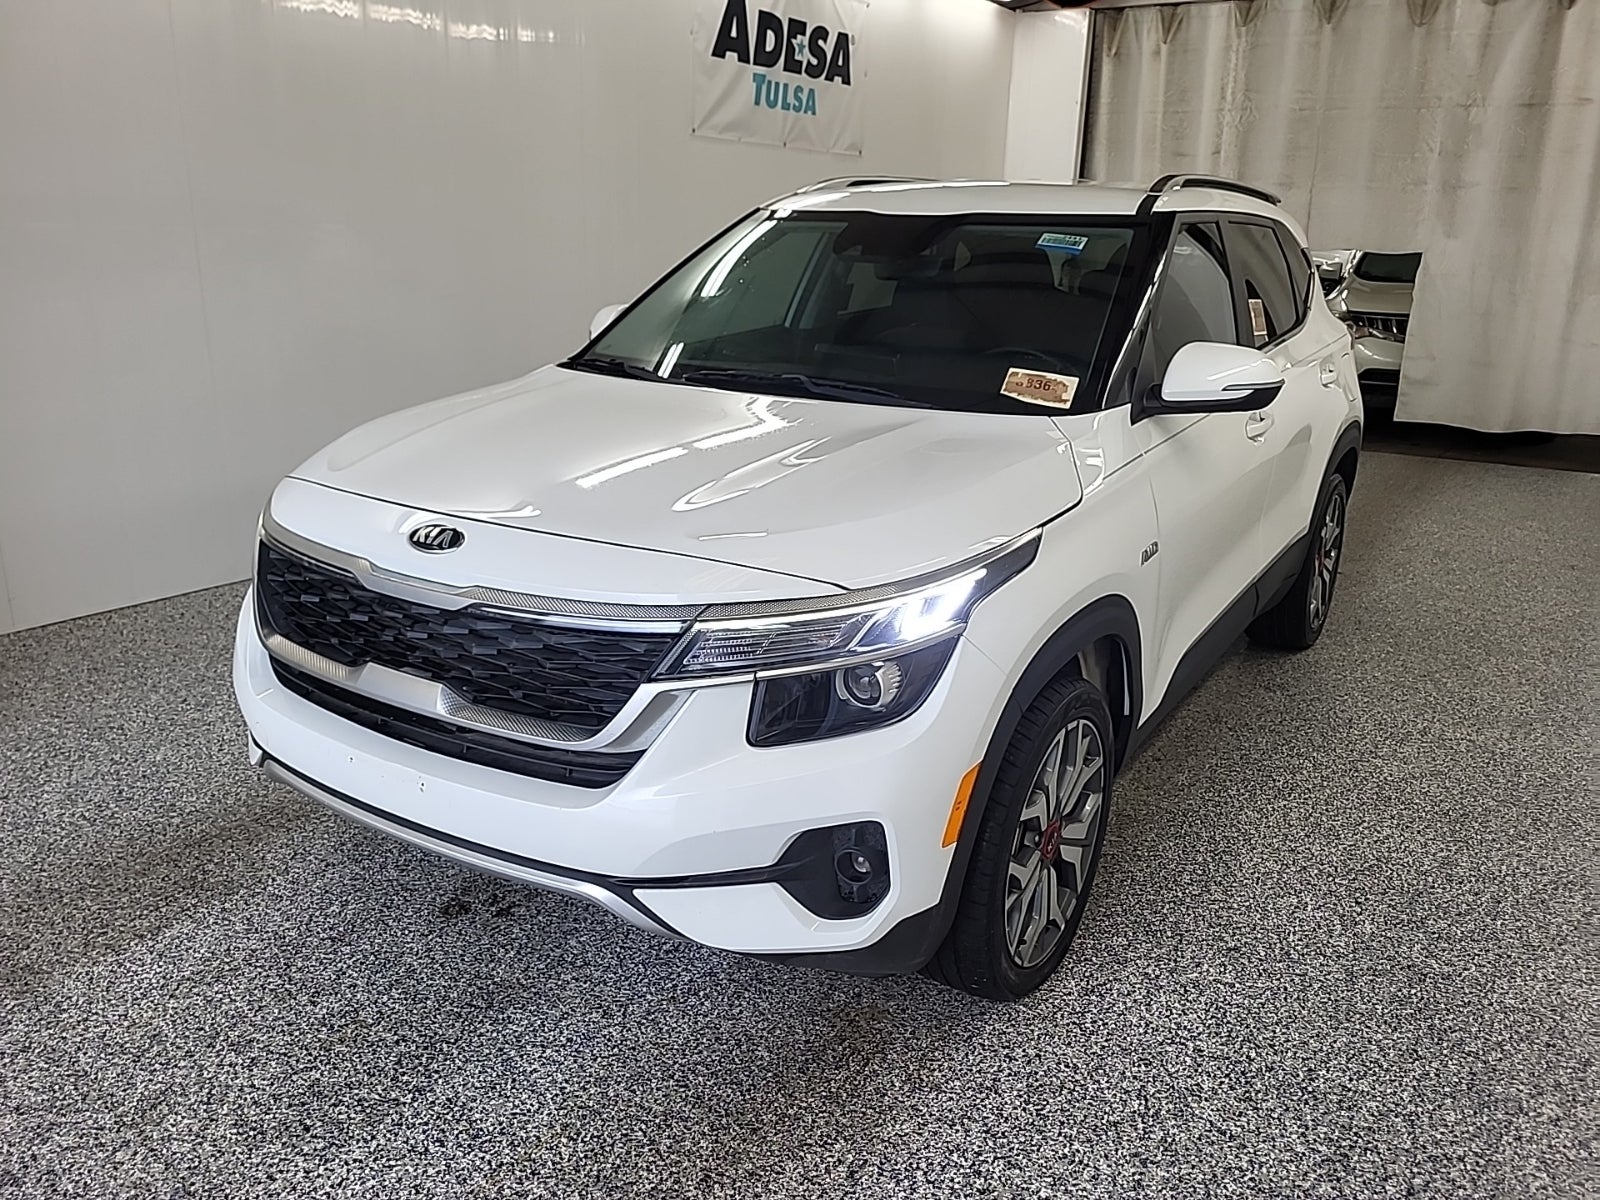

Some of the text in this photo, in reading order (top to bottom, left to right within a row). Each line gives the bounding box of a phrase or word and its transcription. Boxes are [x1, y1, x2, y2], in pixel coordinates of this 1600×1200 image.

[711, 0, 851, 86] ADESA
[752, 72, 817, 116] TULSA
[412, 526, 454, 548] KIA
